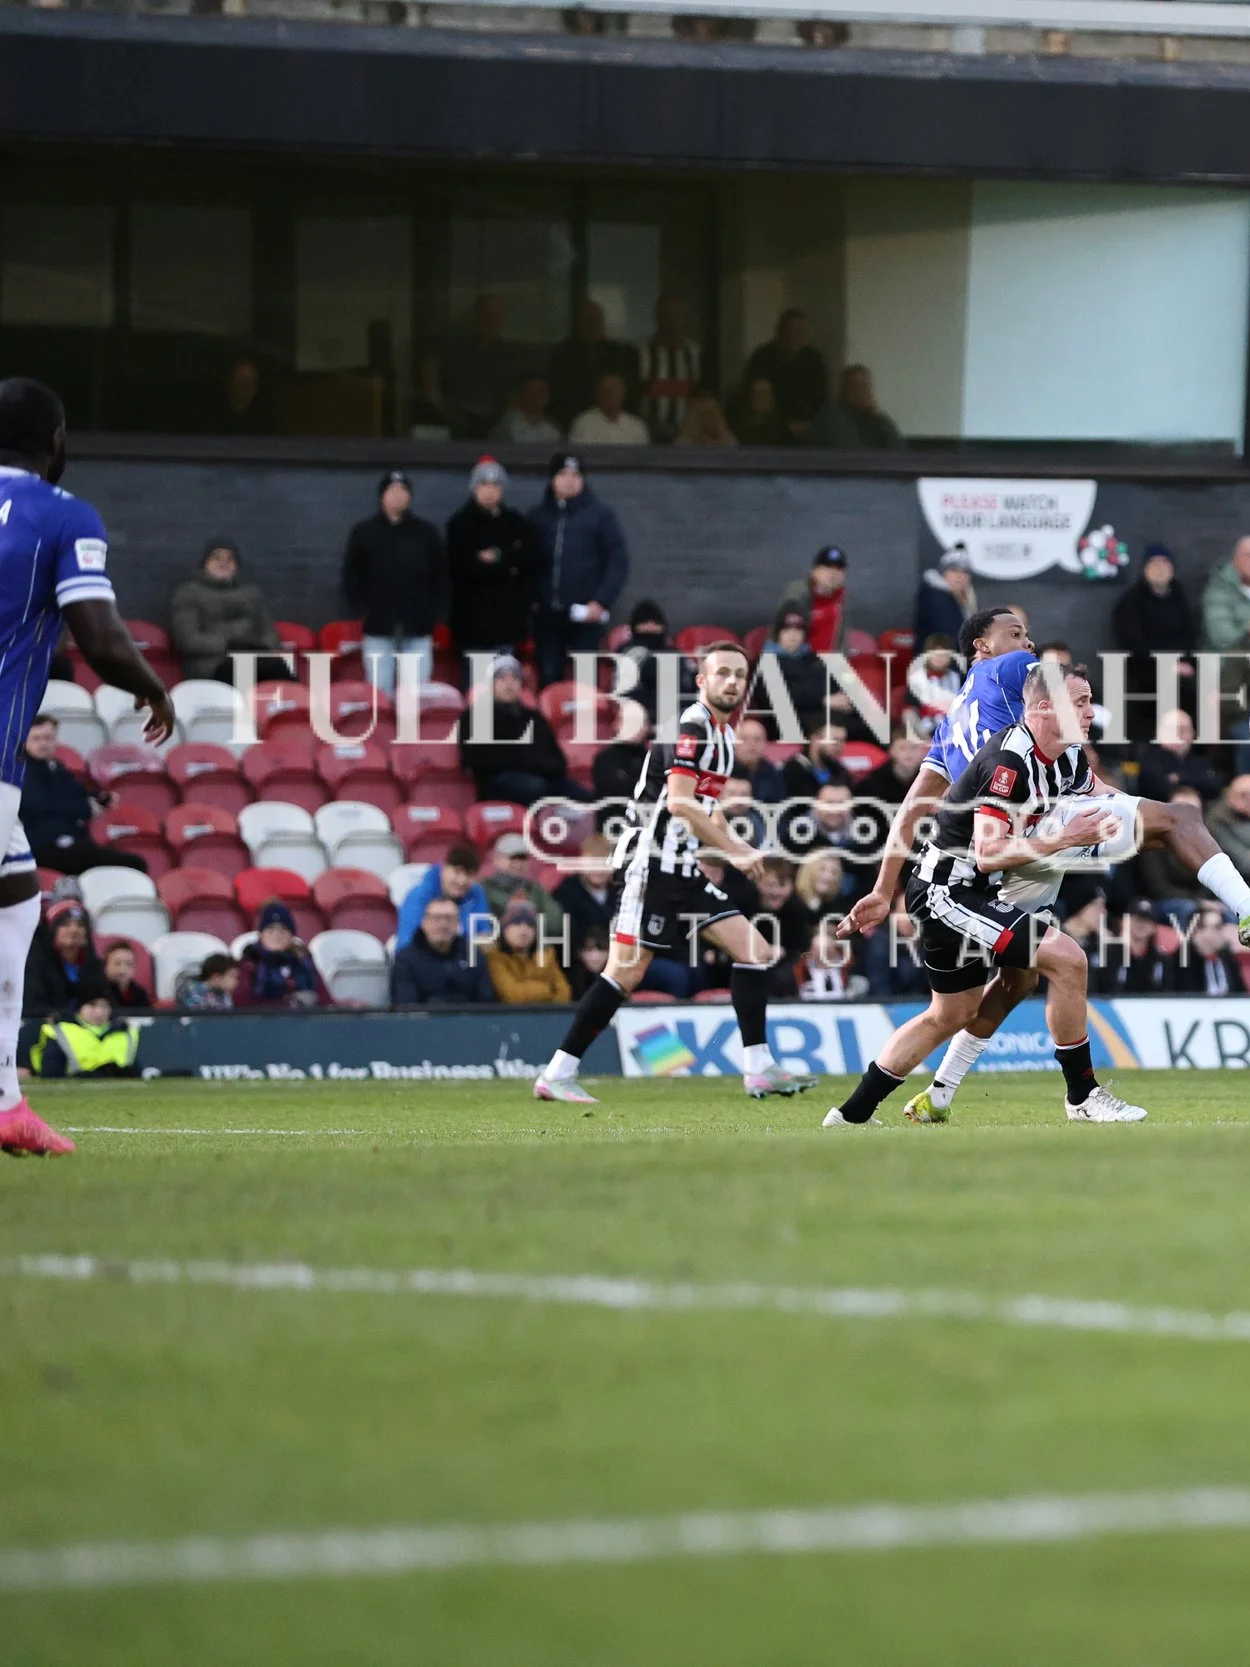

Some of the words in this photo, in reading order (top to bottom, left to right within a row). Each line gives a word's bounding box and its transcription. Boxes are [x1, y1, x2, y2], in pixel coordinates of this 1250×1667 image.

[941, 493, 998, 512] PLEASE
[1002, 494, 1060, 511] WATCH
[942, 513, 984, 530] YOUR
[990, 514, 1072, 530] LANGUAGE
[370, 1060, 494, 1079] Business
